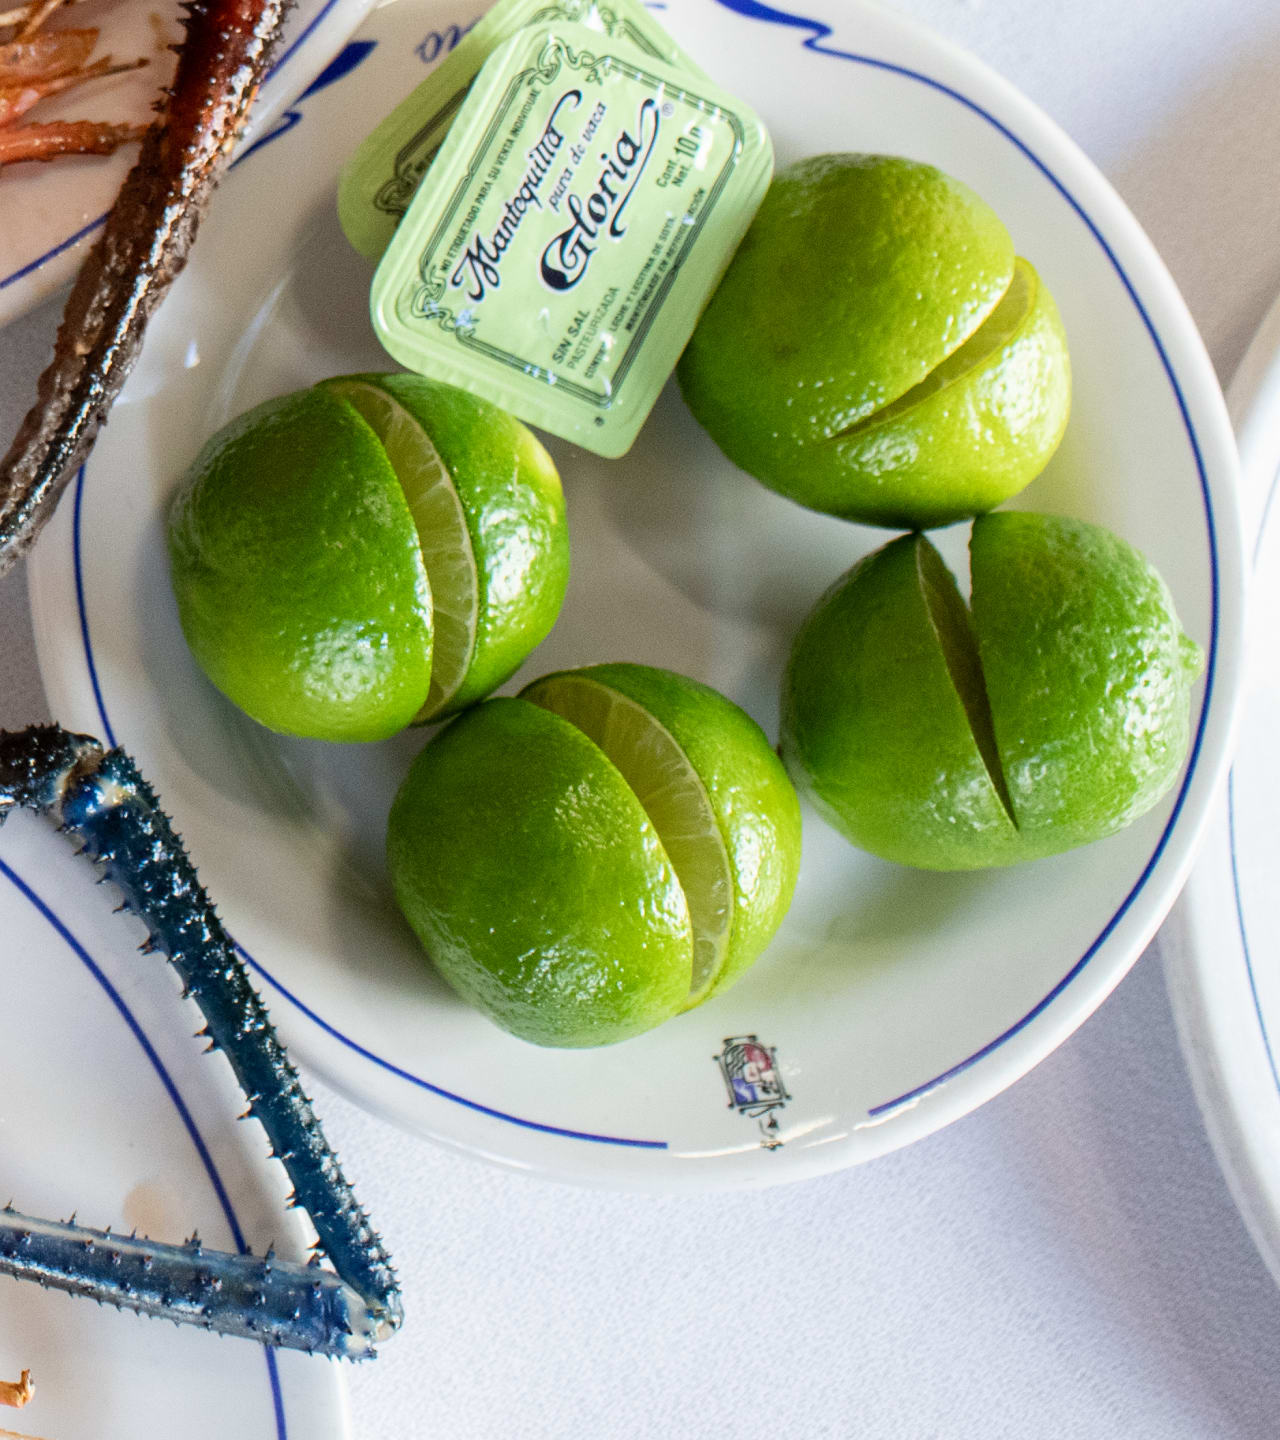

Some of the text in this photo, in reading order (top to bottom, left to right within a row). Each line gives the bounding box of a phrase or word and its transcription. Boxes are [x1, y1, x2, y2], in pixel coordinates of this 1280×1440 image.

[447, 206, 479, 257] ETIQUETADO
[476, 181, 492, 203] PARA
[487, 166, 500, 180] SU
[496, 139, 513, 165] VENTA
[511, 89, 539, 136] INDIVIDUAL
[452, 89, 582, 301] Mantequilla
[540, 98, 661, 291] Gloria
[549, 101, 607, 210] pura de vaca
[673, 136, 698, 160] 10
[552, 308, 588, 363] SIN SAL
[568, 284, 618, 370] PASTEURIZADA
